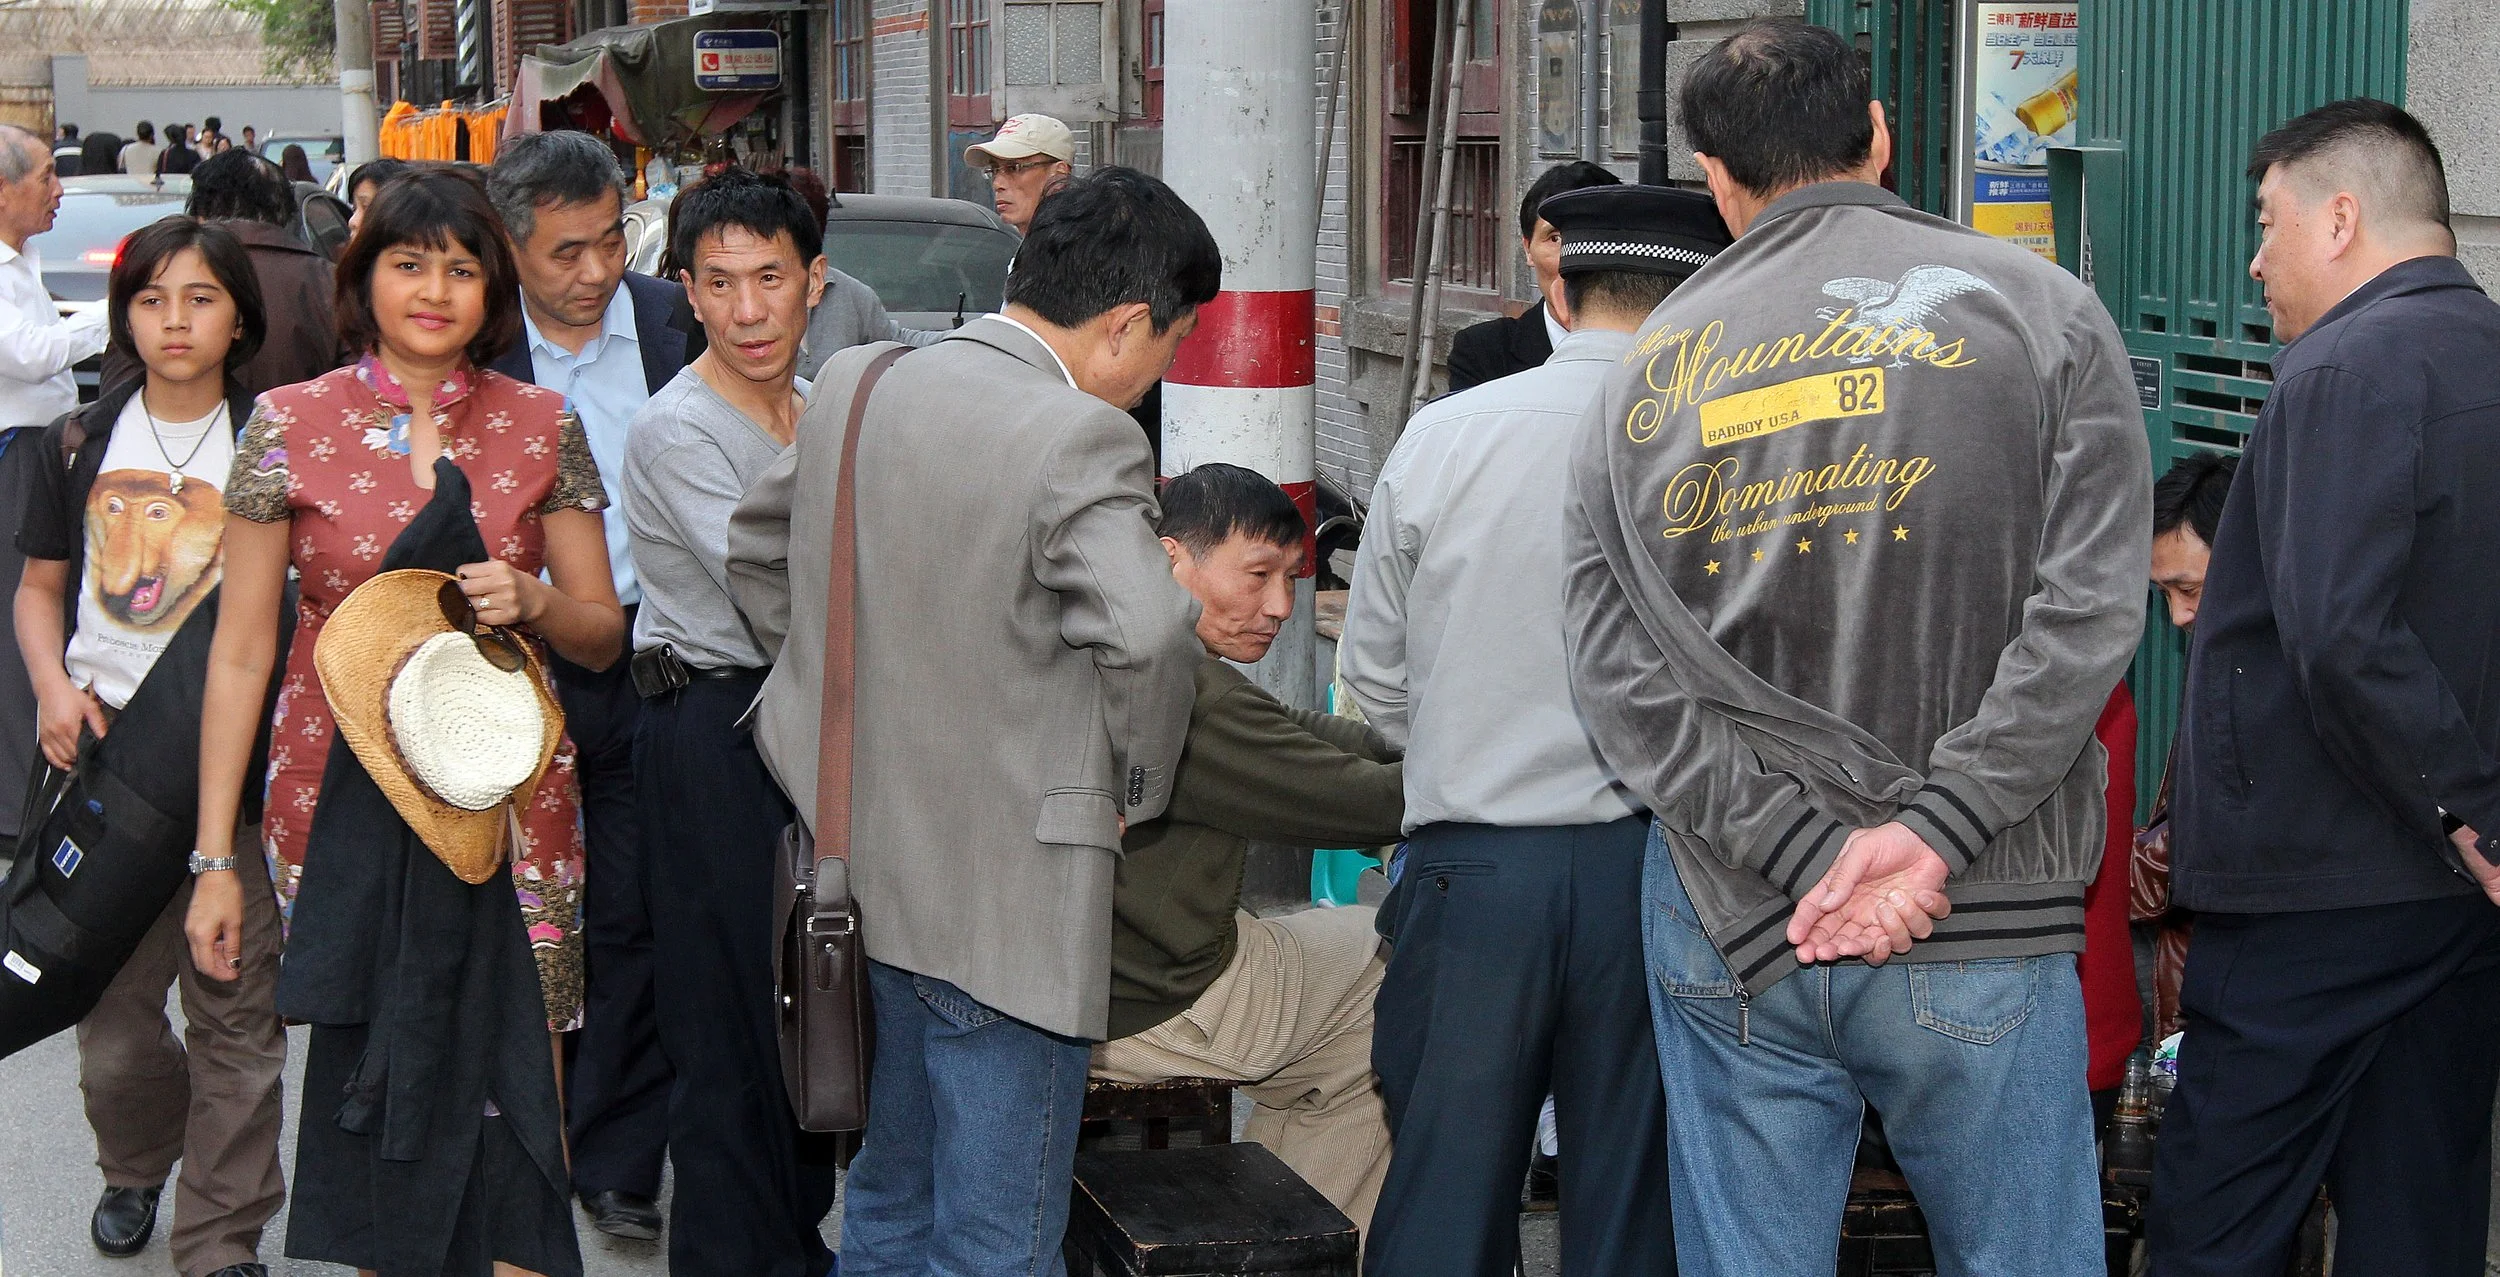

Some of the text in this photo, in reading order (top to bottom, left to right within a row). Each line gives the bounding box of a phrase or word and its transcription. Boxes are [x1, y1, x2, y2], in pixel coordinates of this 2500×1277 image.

[1623, 324, 1695, 367] Move
[1626, 308, 1977, 442] Mountains
[1834, 373, 1878, 412] '82
[1707, 419, 1764, 442] BADBOY
[1663, 443, 1936, 538] Dominating
[1711, 493, 1880, 544] the urban underground
